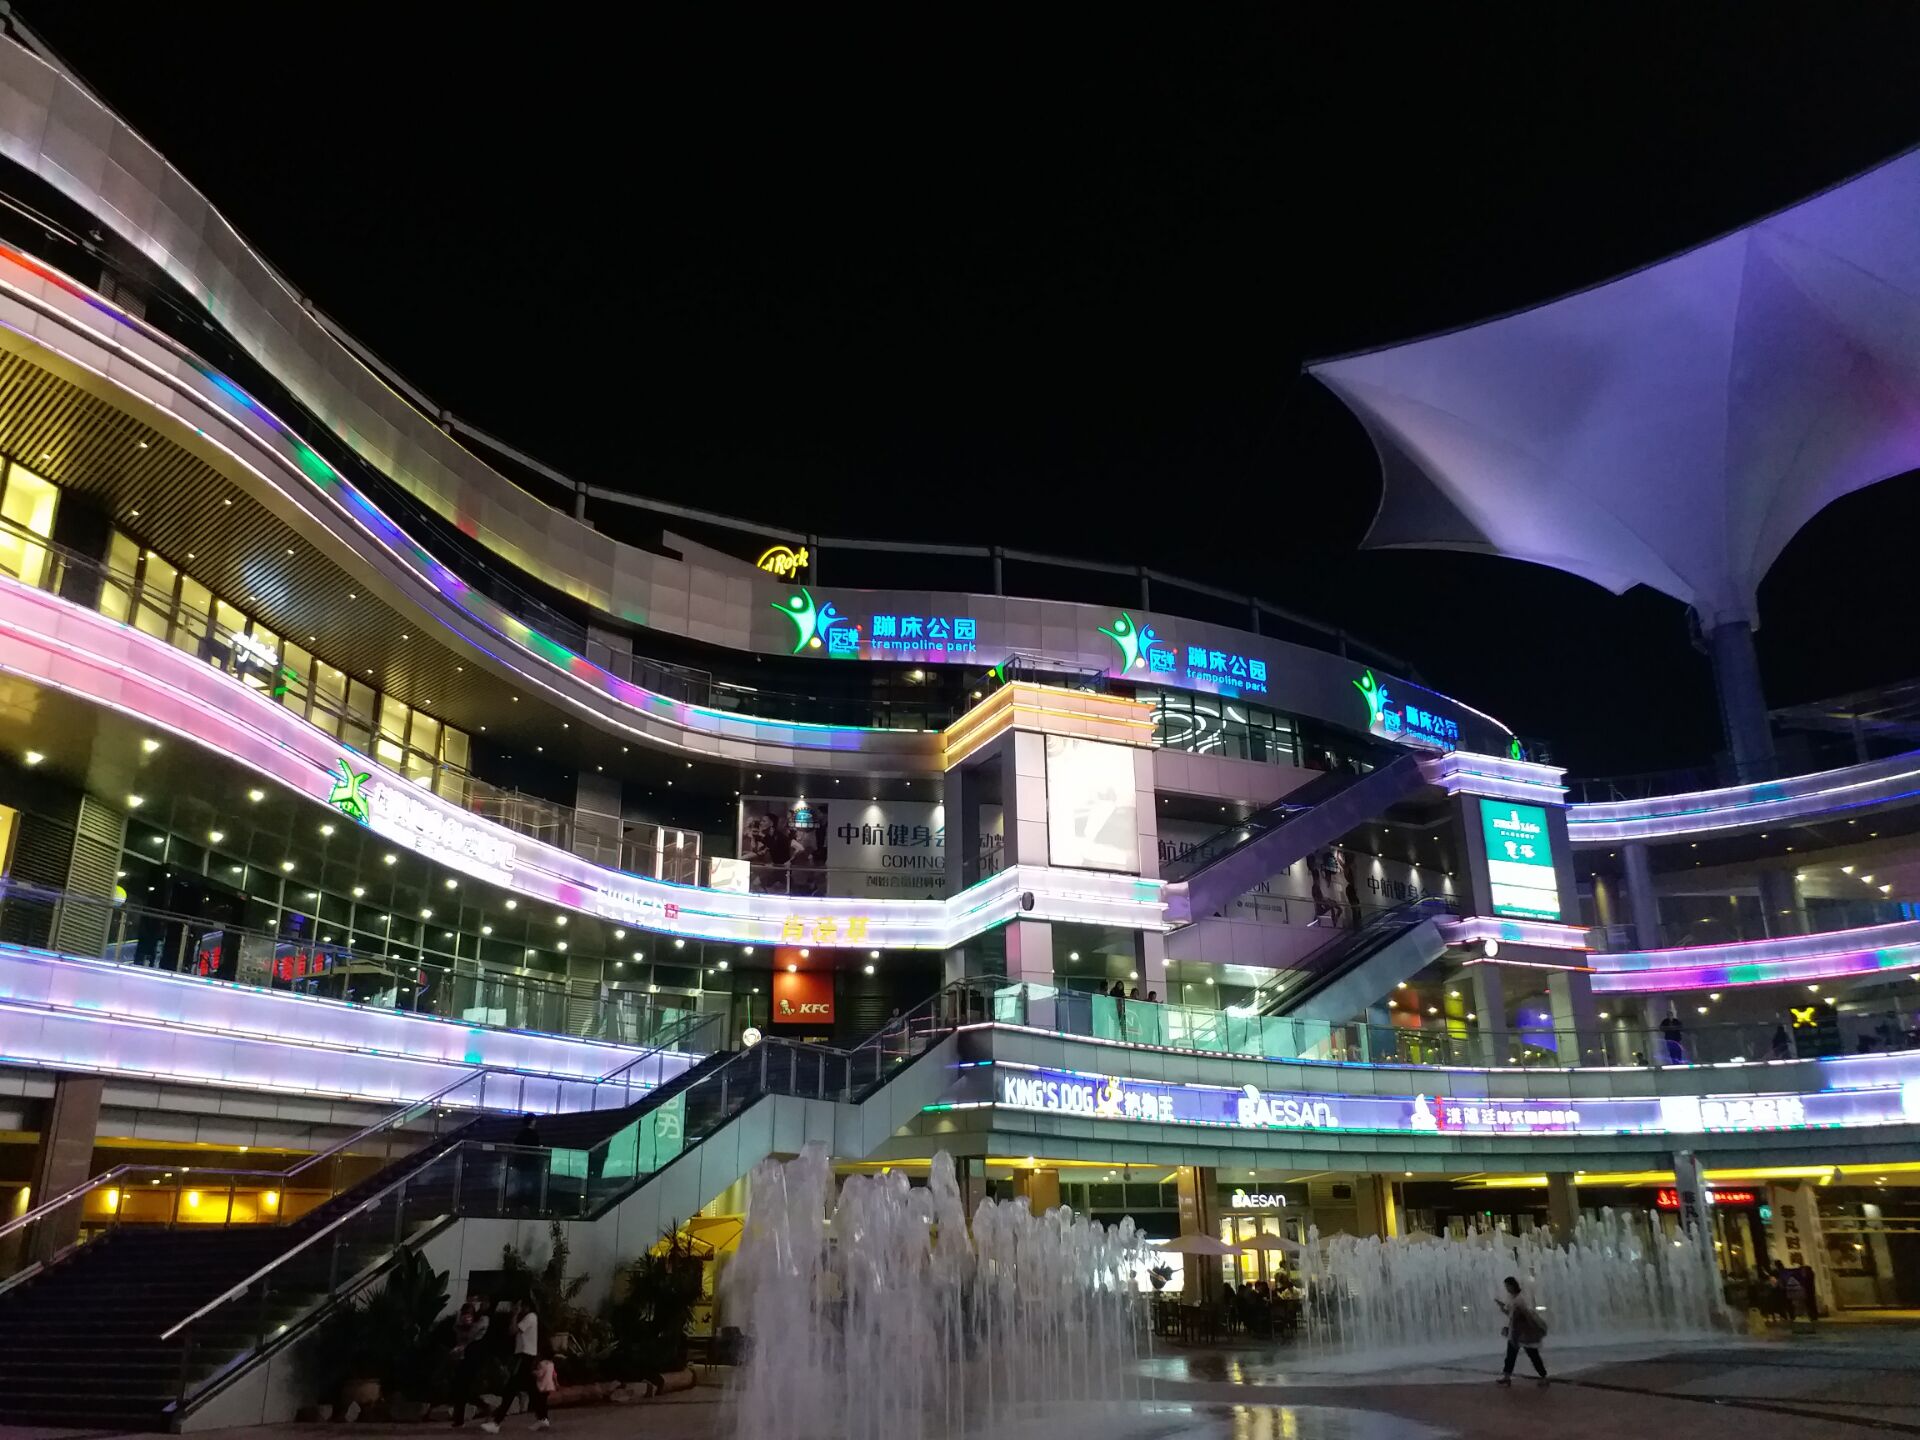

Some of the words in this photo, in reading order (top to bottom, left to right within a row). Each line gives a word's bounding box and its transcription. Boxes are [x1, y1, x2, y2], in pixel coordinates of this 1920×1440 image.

[872, 615, 977, 640] 蹦床公园
[871, 638, 944, 651] trampoline
[946, 639, 977, 652] park
[1187, 646, 1267, 682] 蹦床公园
[1186, 667, 1244, 688] trampoline
[1244, 681, 1268, 693] park
[881, 854, 945, 869] COMING
[782, 913, 870, 944] 肯德基
[799, 1003, 830, 1014] KFC
[1004, 1077, 1058, 1107] KING'S
[1060, 1085, 1094, 1113] DOG
[1232, 1194, 1286, 1208] BAESAN
